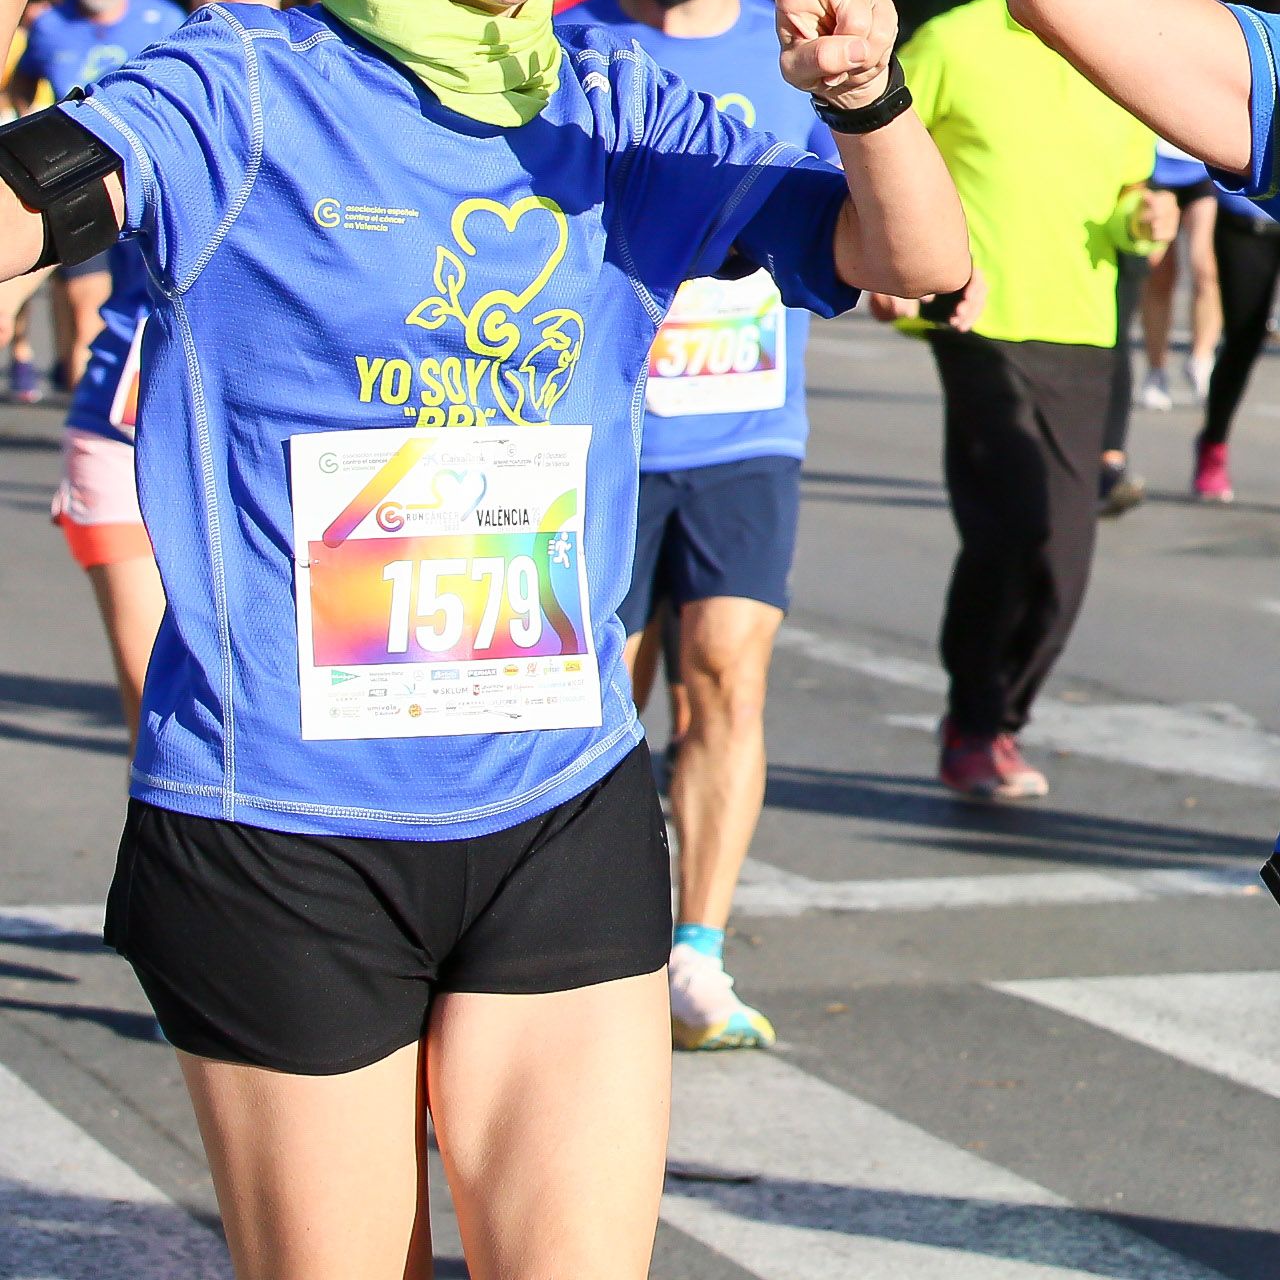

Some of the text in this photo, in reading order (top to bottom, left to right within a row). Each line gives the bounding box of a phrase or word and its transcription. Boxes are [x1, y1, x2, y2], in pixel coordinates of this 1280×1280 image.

[655, 325, 760, 377] 3706
[355, 355, 492, 406] YO SOY
[382, 555, 543, 654] 1579
[440, 687, 468, 695] SKLUM
